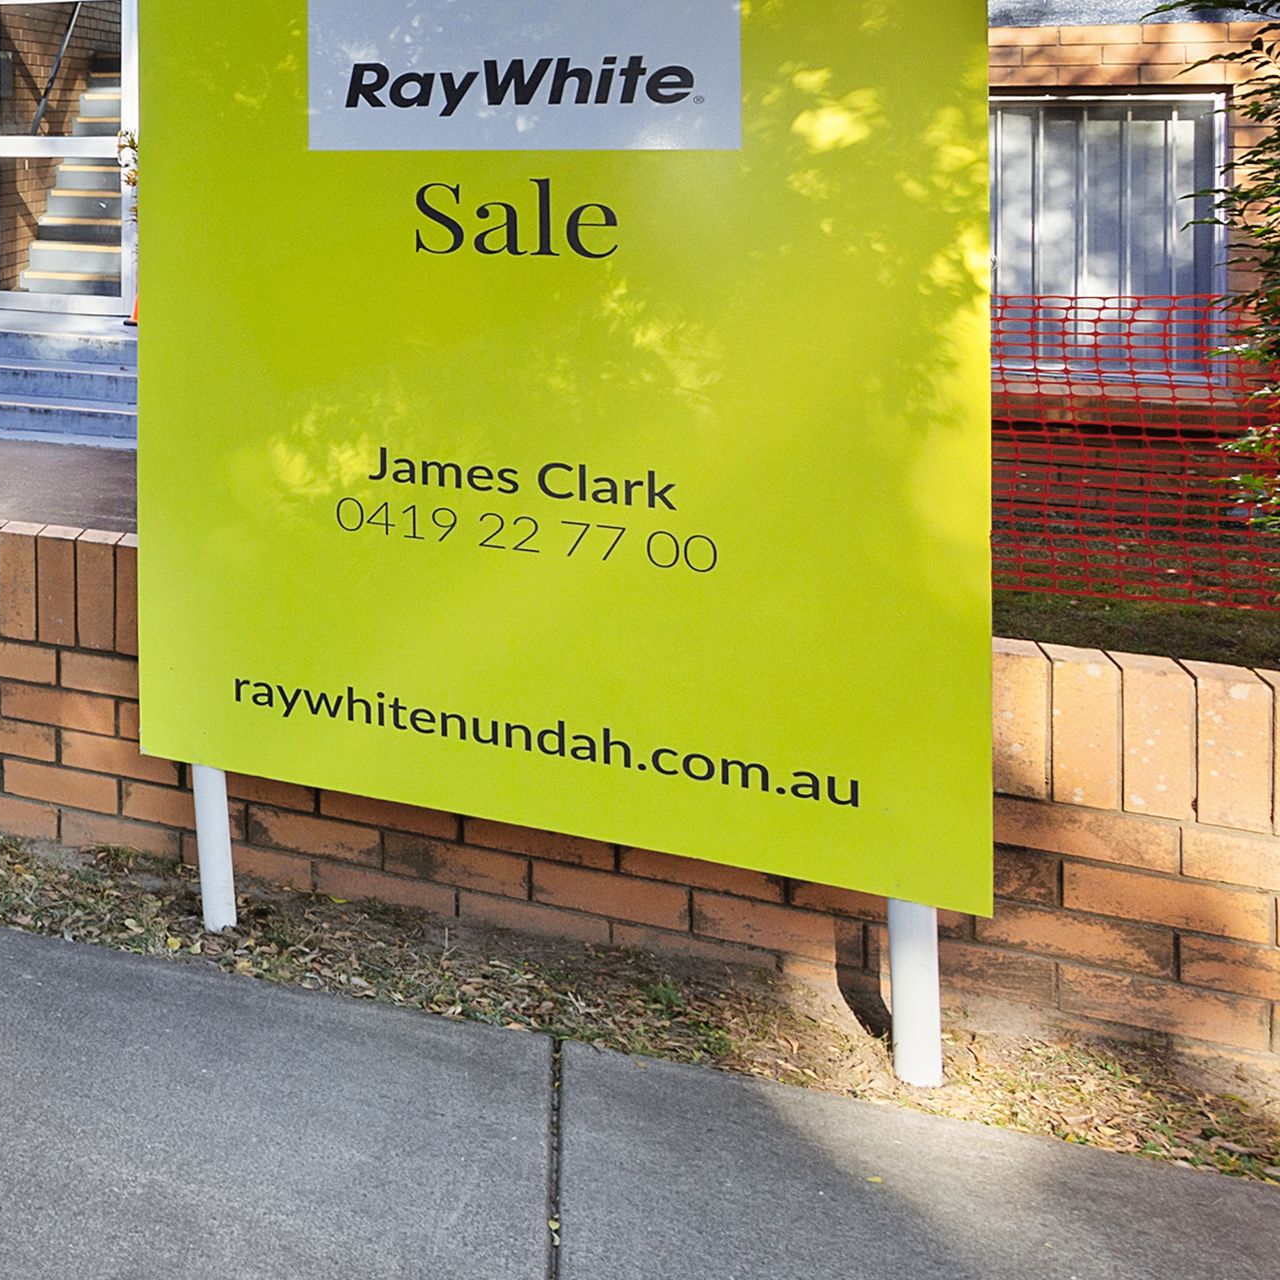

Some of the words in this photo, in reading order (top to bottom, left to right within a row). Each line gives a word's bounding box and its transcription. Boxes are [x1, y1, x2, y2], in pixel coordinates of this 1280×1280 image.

[415, 177, 618, 259] Sale
[368, 446, 519, 495] James
[537, 462, 677, 511] Clark
[336, 497, 458, 542] 0419
[478, 512, 540, 553] 22
[561, 520, 626, 561] 77
[646, 530, 718, 573] 00
[234, 677, 860, 808] raywhitenundah.com.au
